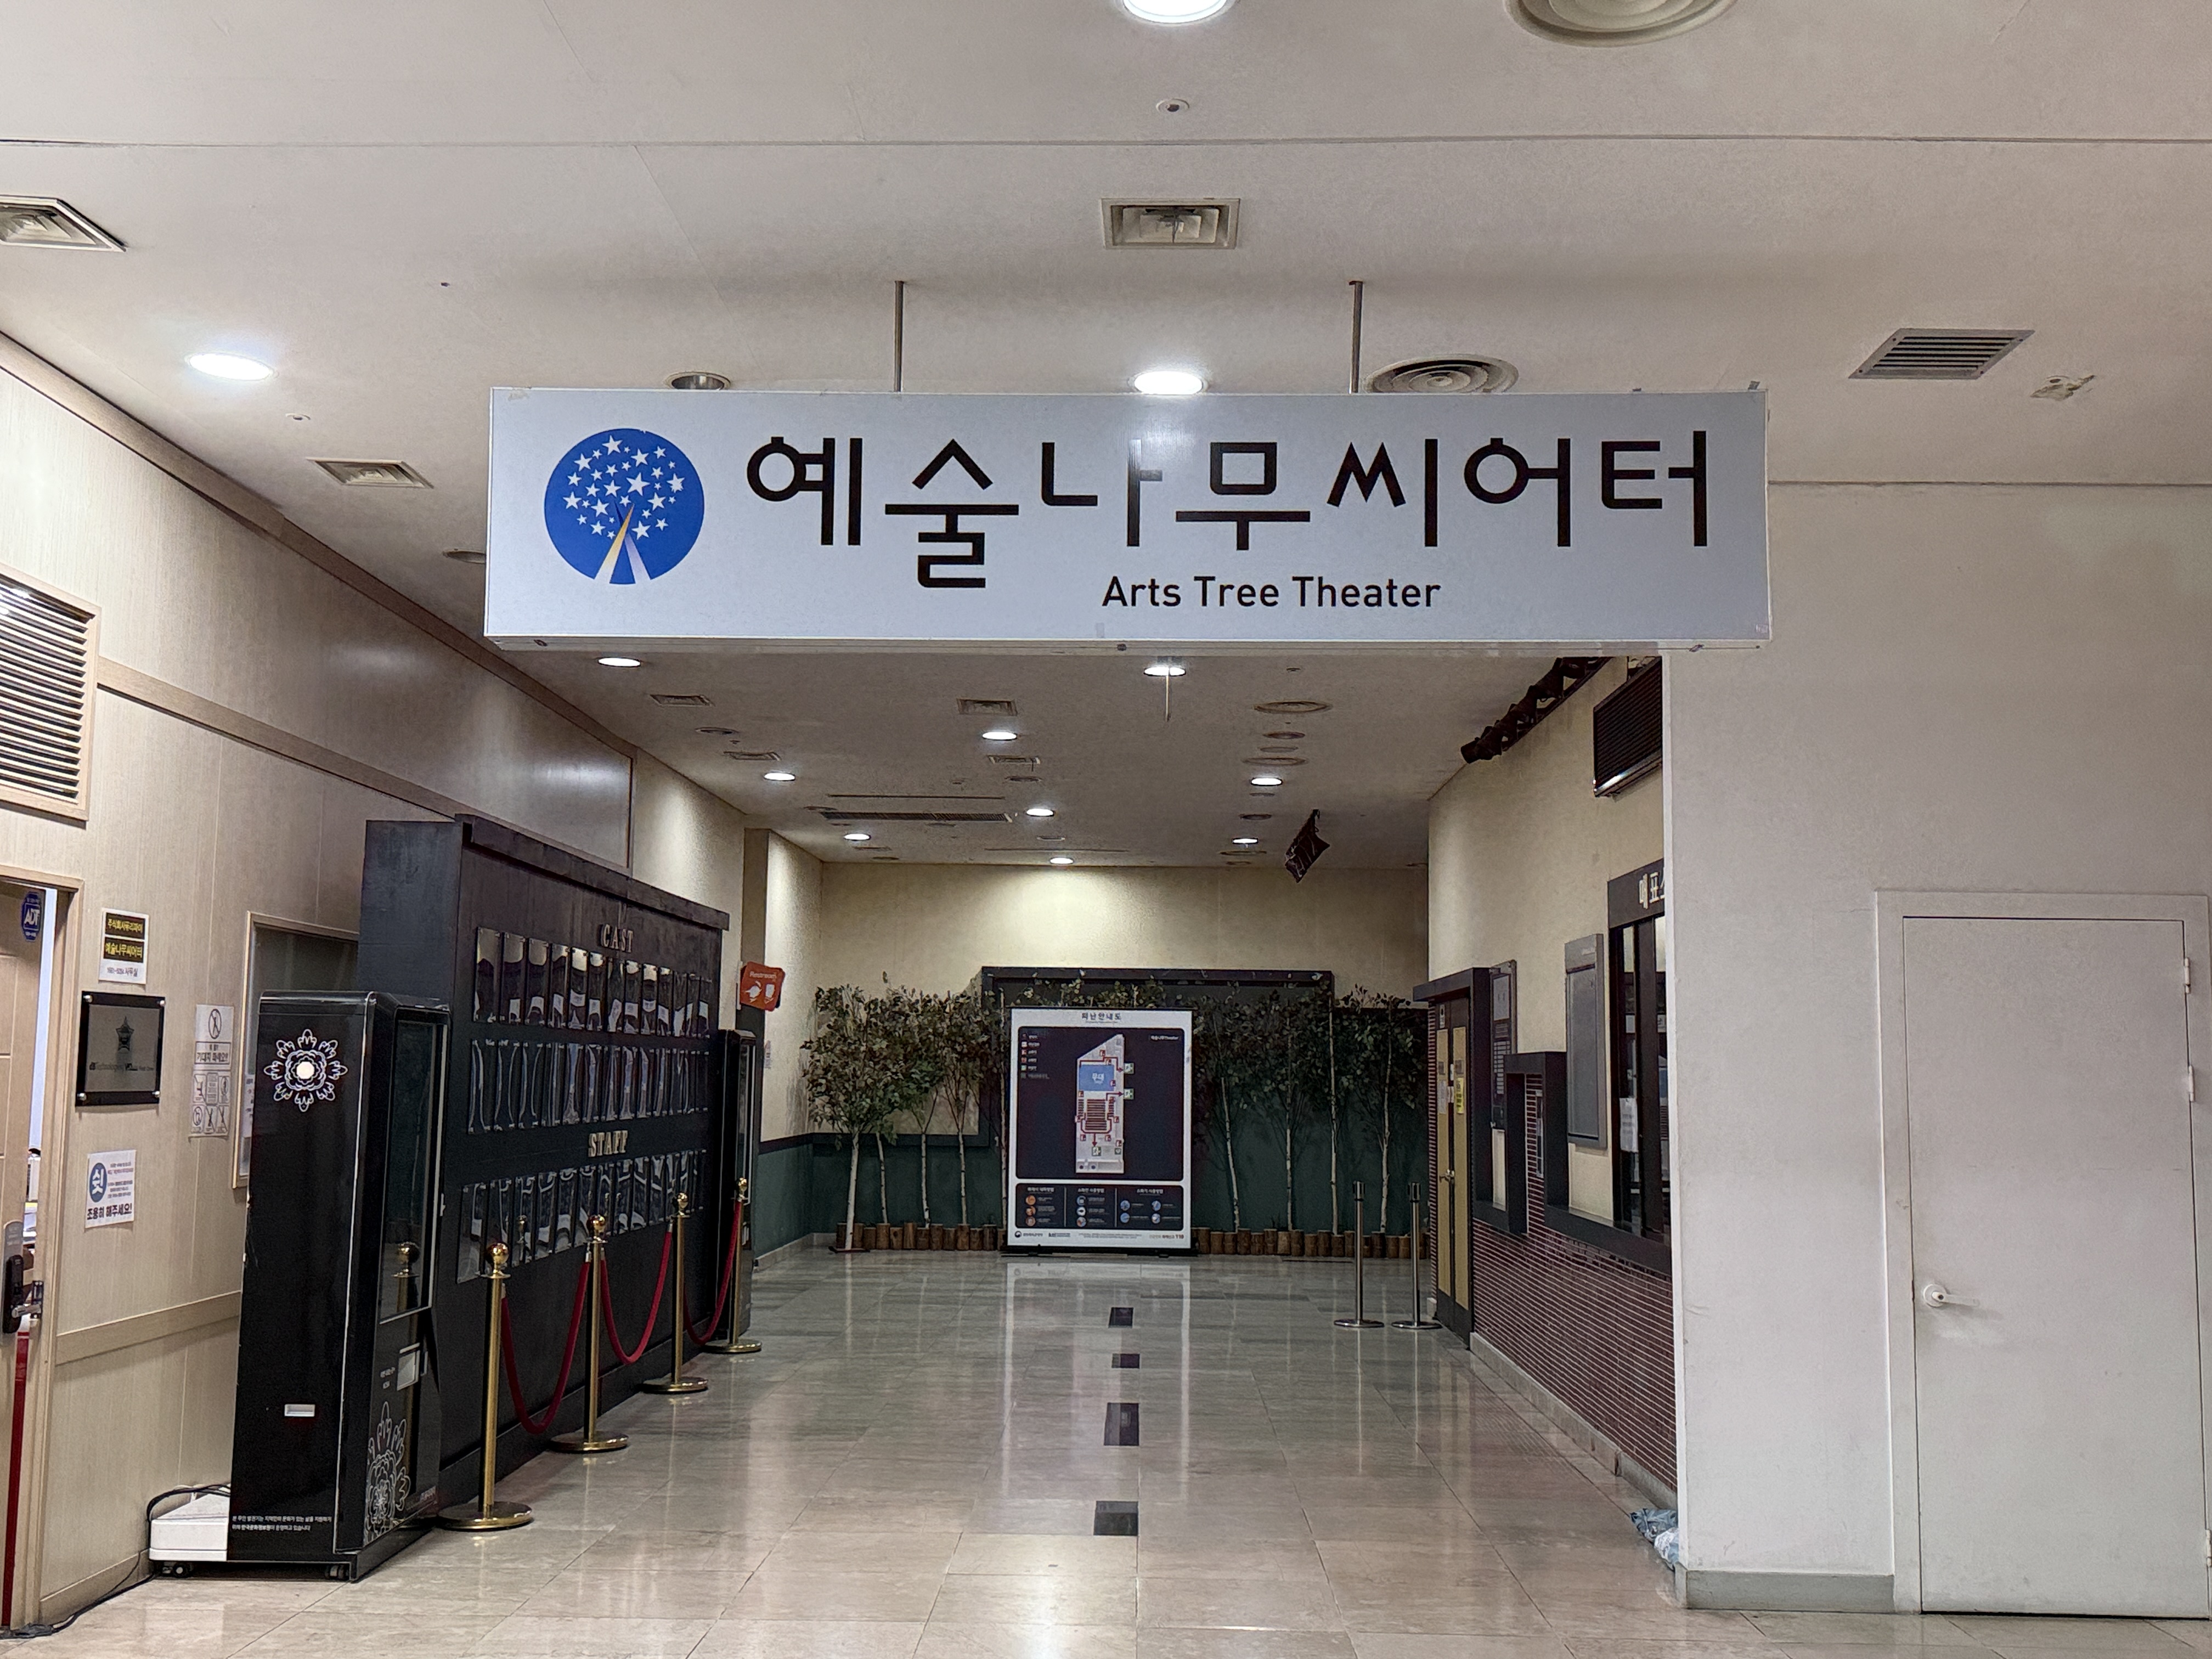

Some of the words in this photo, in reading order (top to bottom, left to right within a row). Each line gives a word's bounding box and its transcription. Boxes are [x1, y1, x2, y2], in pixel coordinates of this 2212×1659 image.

[747, 431, 1707, 588] 예술나무씨어터
[1102, 577, 1181, 606] Arts
[1194, 577, 1278, 606] Tree
[1293, 577, 1441, 607] Theater
[24, 907, 40, 926] ADT
[601, 924, 634, 953] CAST
[588, 1130, 628, 1158] STAFF
[87, 1206, 105, 1221] 조용히
